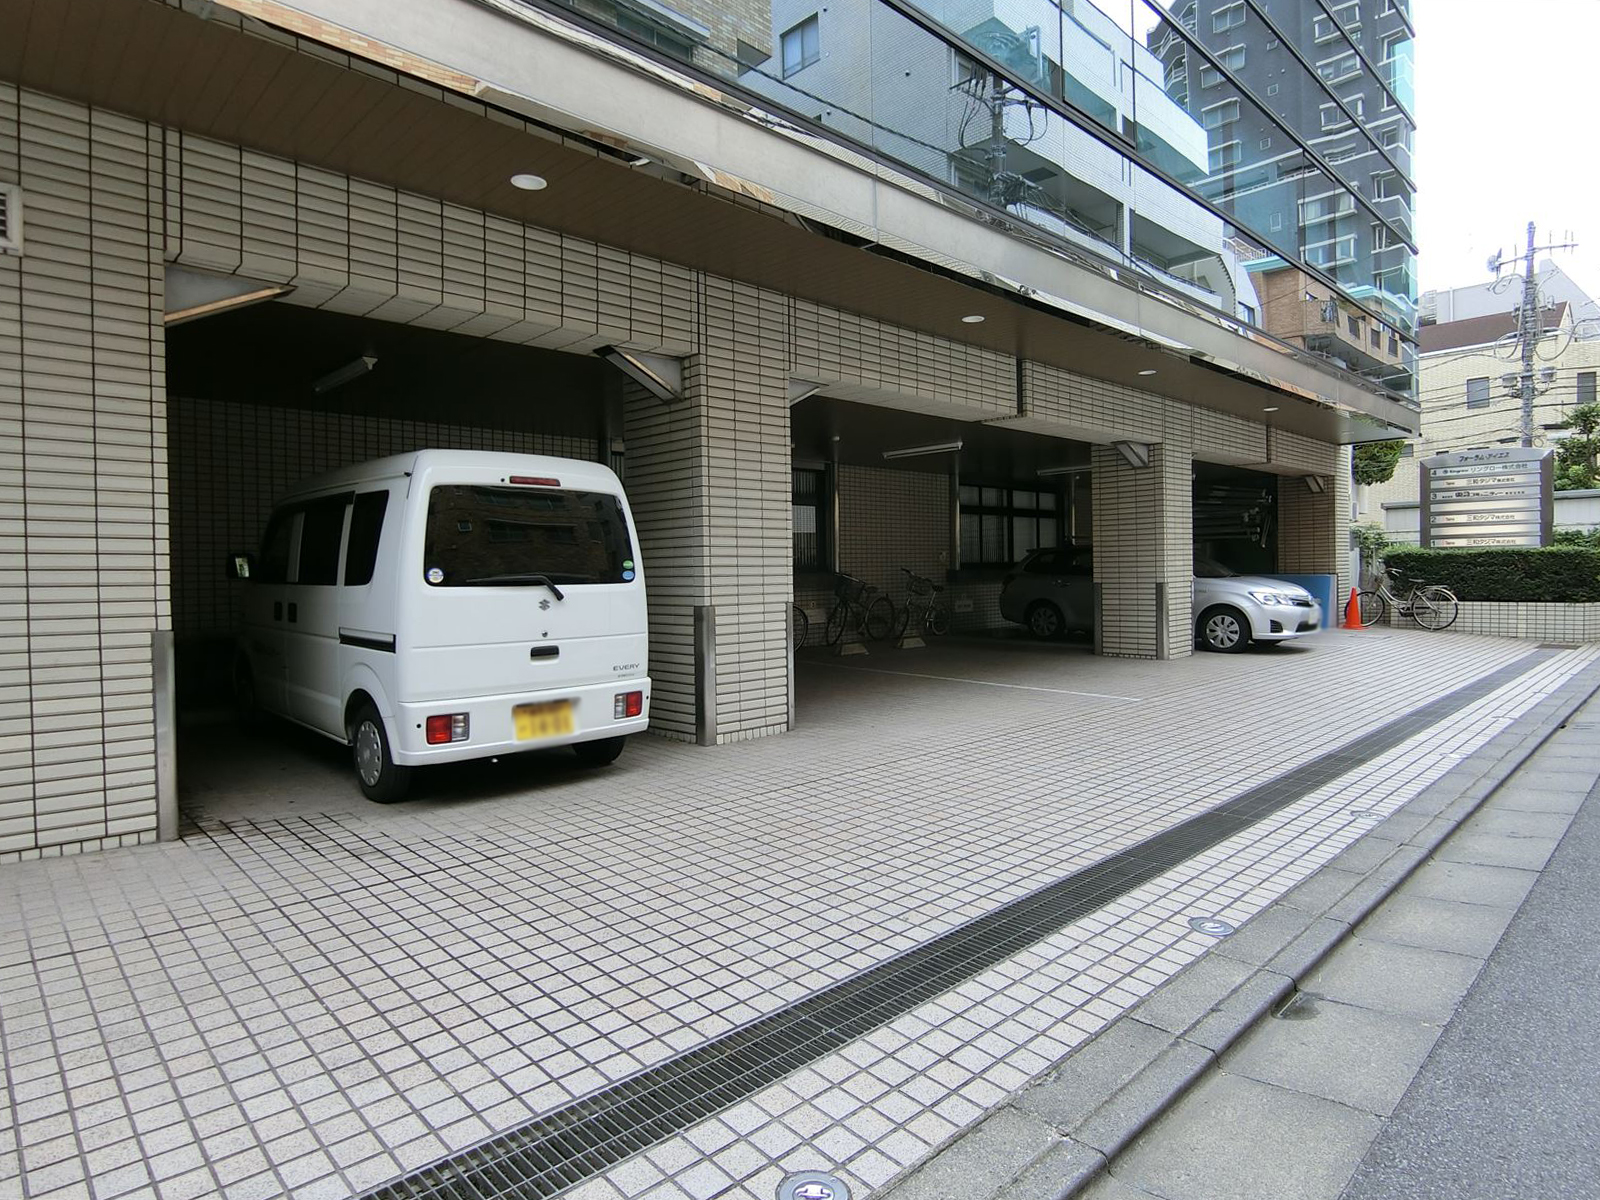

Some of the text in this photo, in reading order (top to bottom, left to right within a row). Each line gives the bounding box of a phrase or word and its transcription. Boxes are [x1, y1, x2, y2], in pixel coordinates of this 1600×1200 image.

[1470, 463, 1528, 473] リングロー株式会社
[613, 663, 640, 671] EVERY
